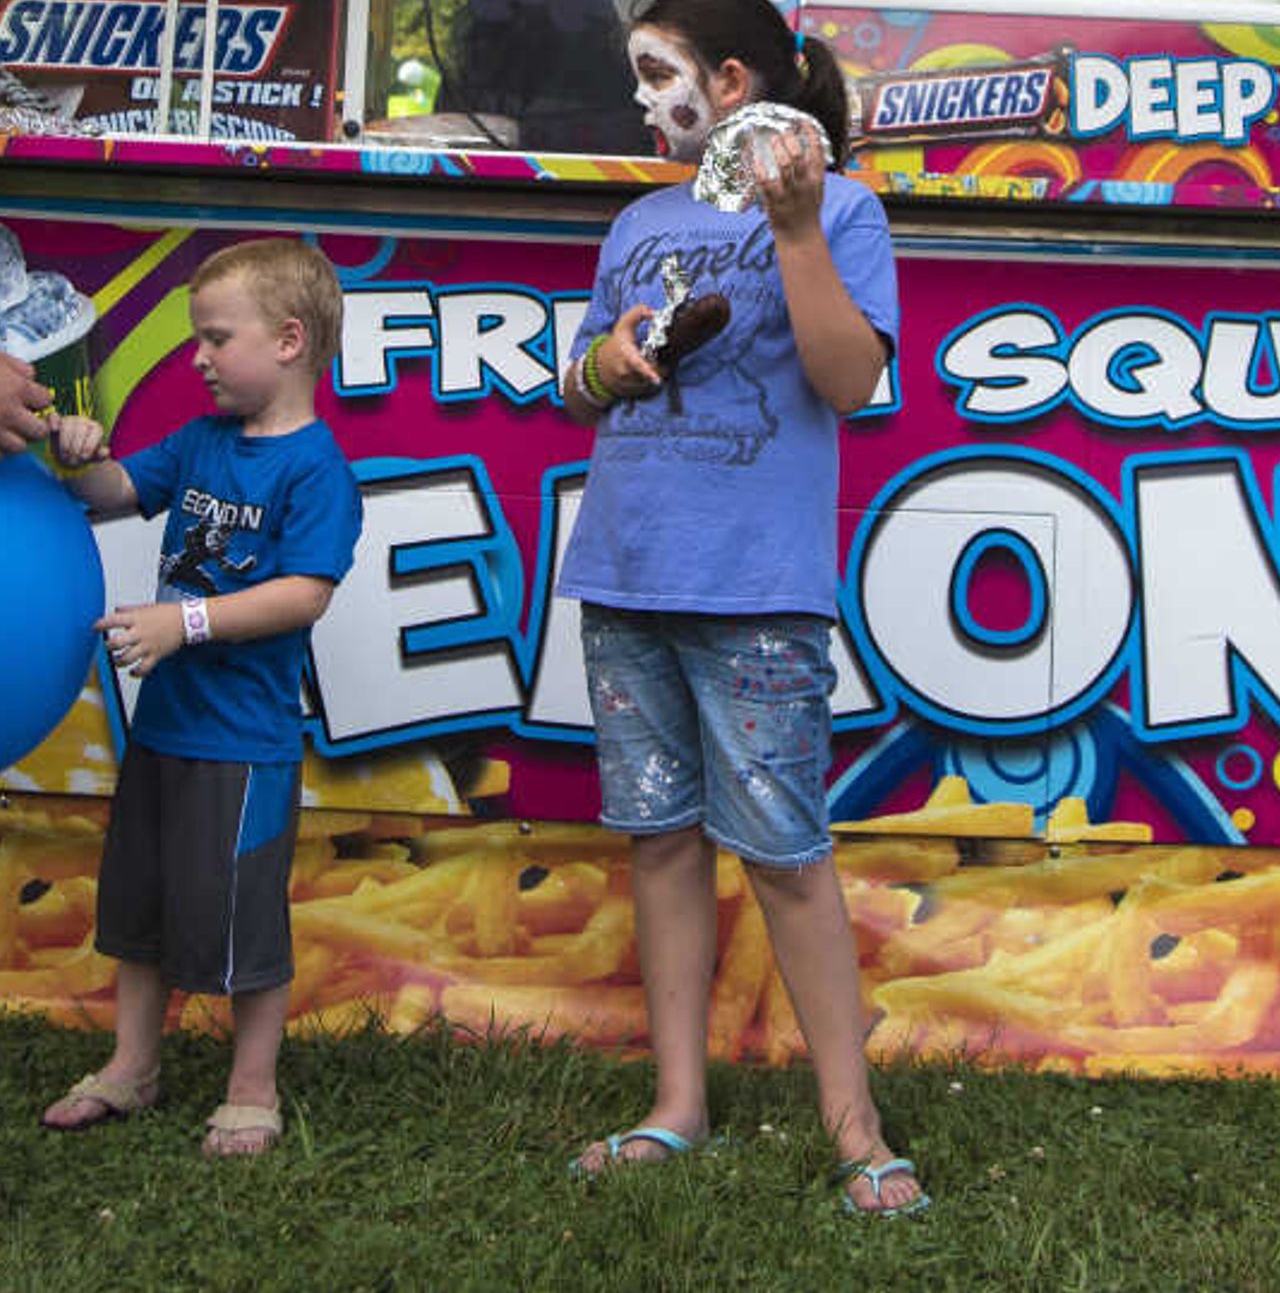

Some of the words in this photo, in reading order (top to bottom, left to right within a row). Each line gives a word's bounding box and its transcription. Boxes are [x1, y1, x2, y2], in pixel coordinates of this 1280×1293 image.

[131, 79, 170, 102] O
[214, 82, 303, 107] STICK
[876, 72, 1047, 127] SNICKERS
[1070, 54, 1276, 144] DEEP
